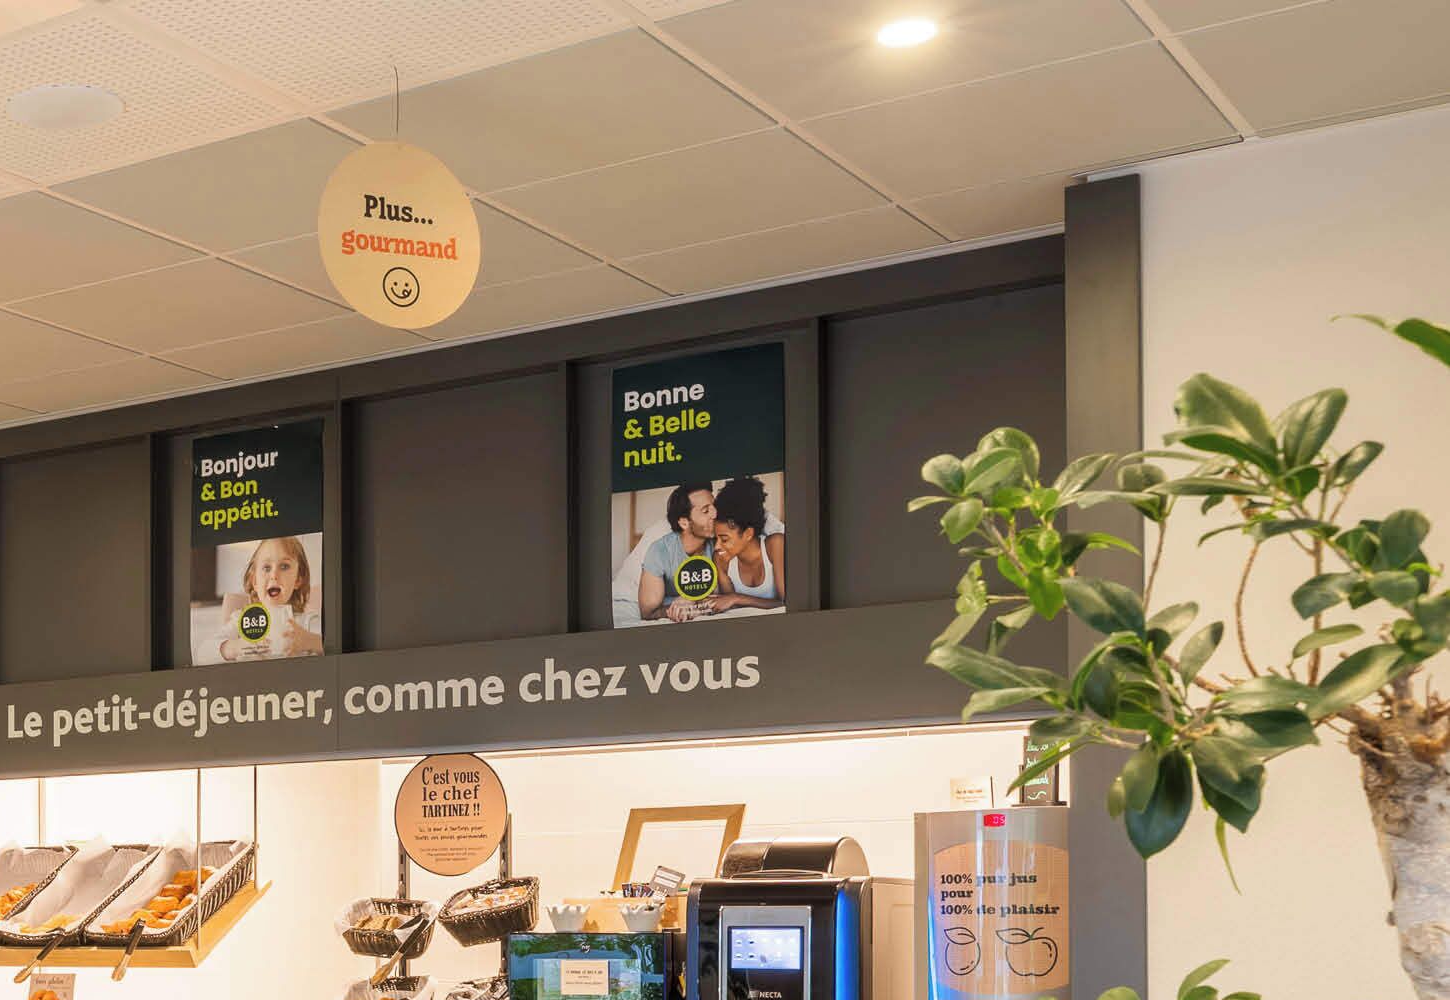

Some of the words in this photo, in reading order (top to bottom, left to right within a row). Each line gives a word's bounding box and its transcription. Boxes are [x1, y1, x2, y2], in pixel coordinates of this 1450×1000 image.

[364, 194, 433, 224] Plus...
[341, 229, 458, 260] gourmand
[624, 383, 705, 412] Bonne
[623, 418, 644, 439] &
[649, 408, 711, 436] Belle
[201, 451, 278, 478] Bonjour
[623, 441, 682, 468] nuit.
[200, 483, 216, 501] &
[220, 479, 258, 499] Bon
[200, 498, 279, 530] appétit.
[680, 568, 712, 585] B&B
[242, 615, 267, 629] B&B
[7, 704, 43, 739] Le
[53, 687, 333, 747] petit-déjeuner,
[344, 675, 505, 715] comme
[518, 658, 627, 702] chez
[639, 655, 761, 694] vous
[421, 766, 450, 785] C'est
[453, 771, 480, 784] vous
[422, 786, 438, 802] le
[443, 784, 480, 801] chef
[422, 803, 470, 818] TARTINEZ
[473, 803, 480, 816] !!
[941, 874, 973, 884] 100%
[976, 875, 1006, 886] pur
[1009, 873, 1037, 886] jus
[941, 890, 973, 901] pour
[941, 905, 973, 915] 100%
[976, 904, 996, 915] de
[1000, 904, 1060, 918] plaisir
